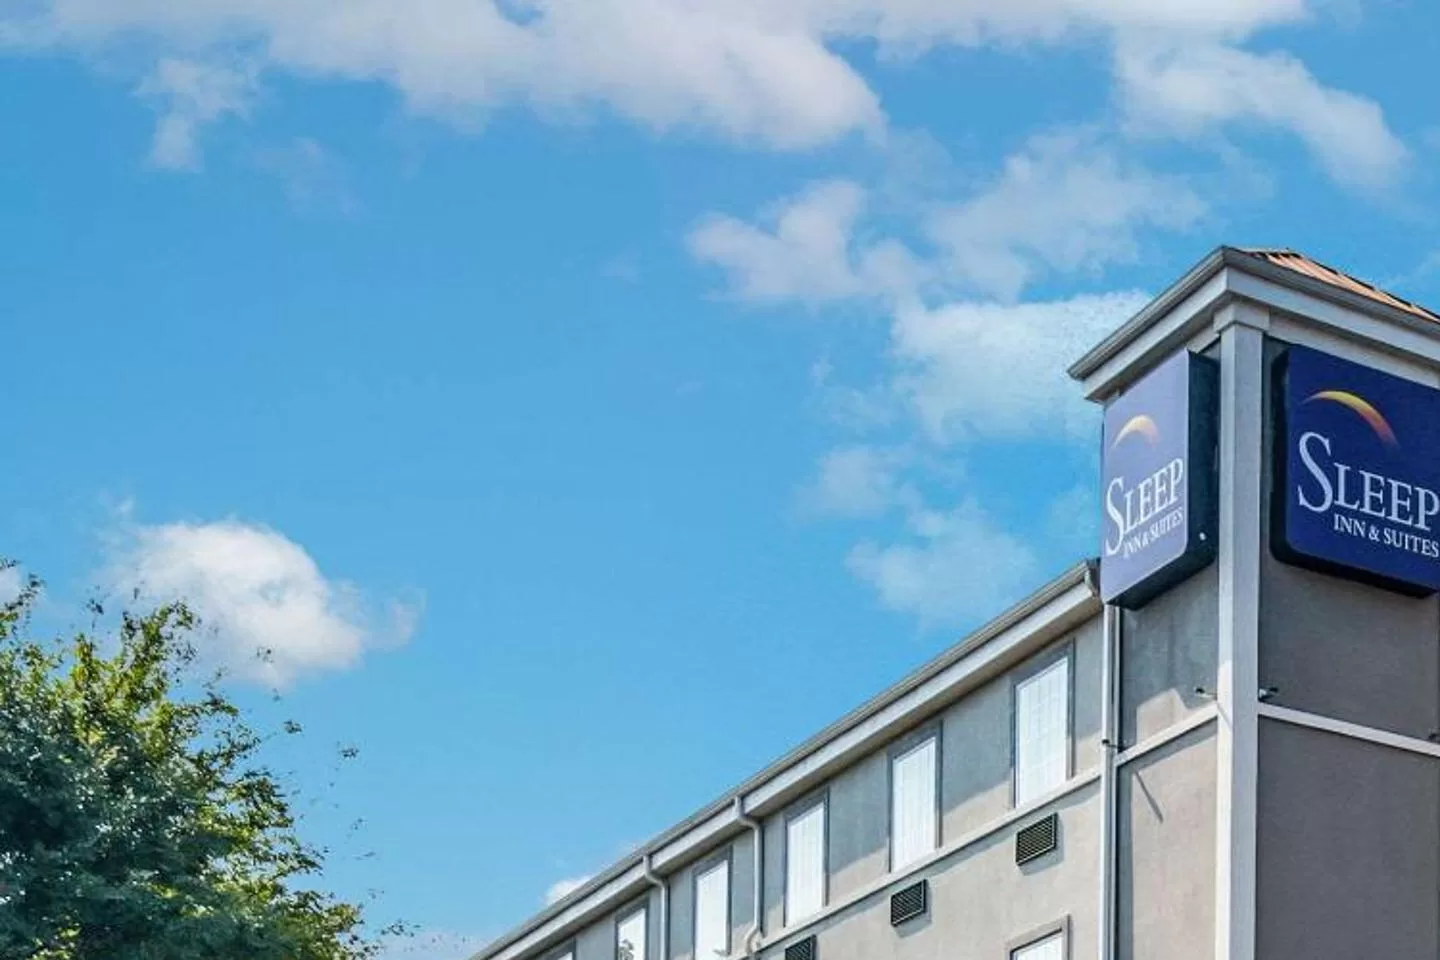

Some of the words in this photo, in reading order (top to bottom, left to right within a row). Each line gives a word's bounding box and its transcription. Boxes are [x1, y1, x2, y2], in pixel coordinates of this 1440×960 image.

[1104, 458, 1183, 557] SLEEP
[1298, 431, 1440, 532] SLEEP
[1149, 506, 1183, 542] SUITES
[1334, 513, 1366, 538] INN
[1368, 525, 1380, 542] &
[1383, 527, 1440, 558] SUITES
